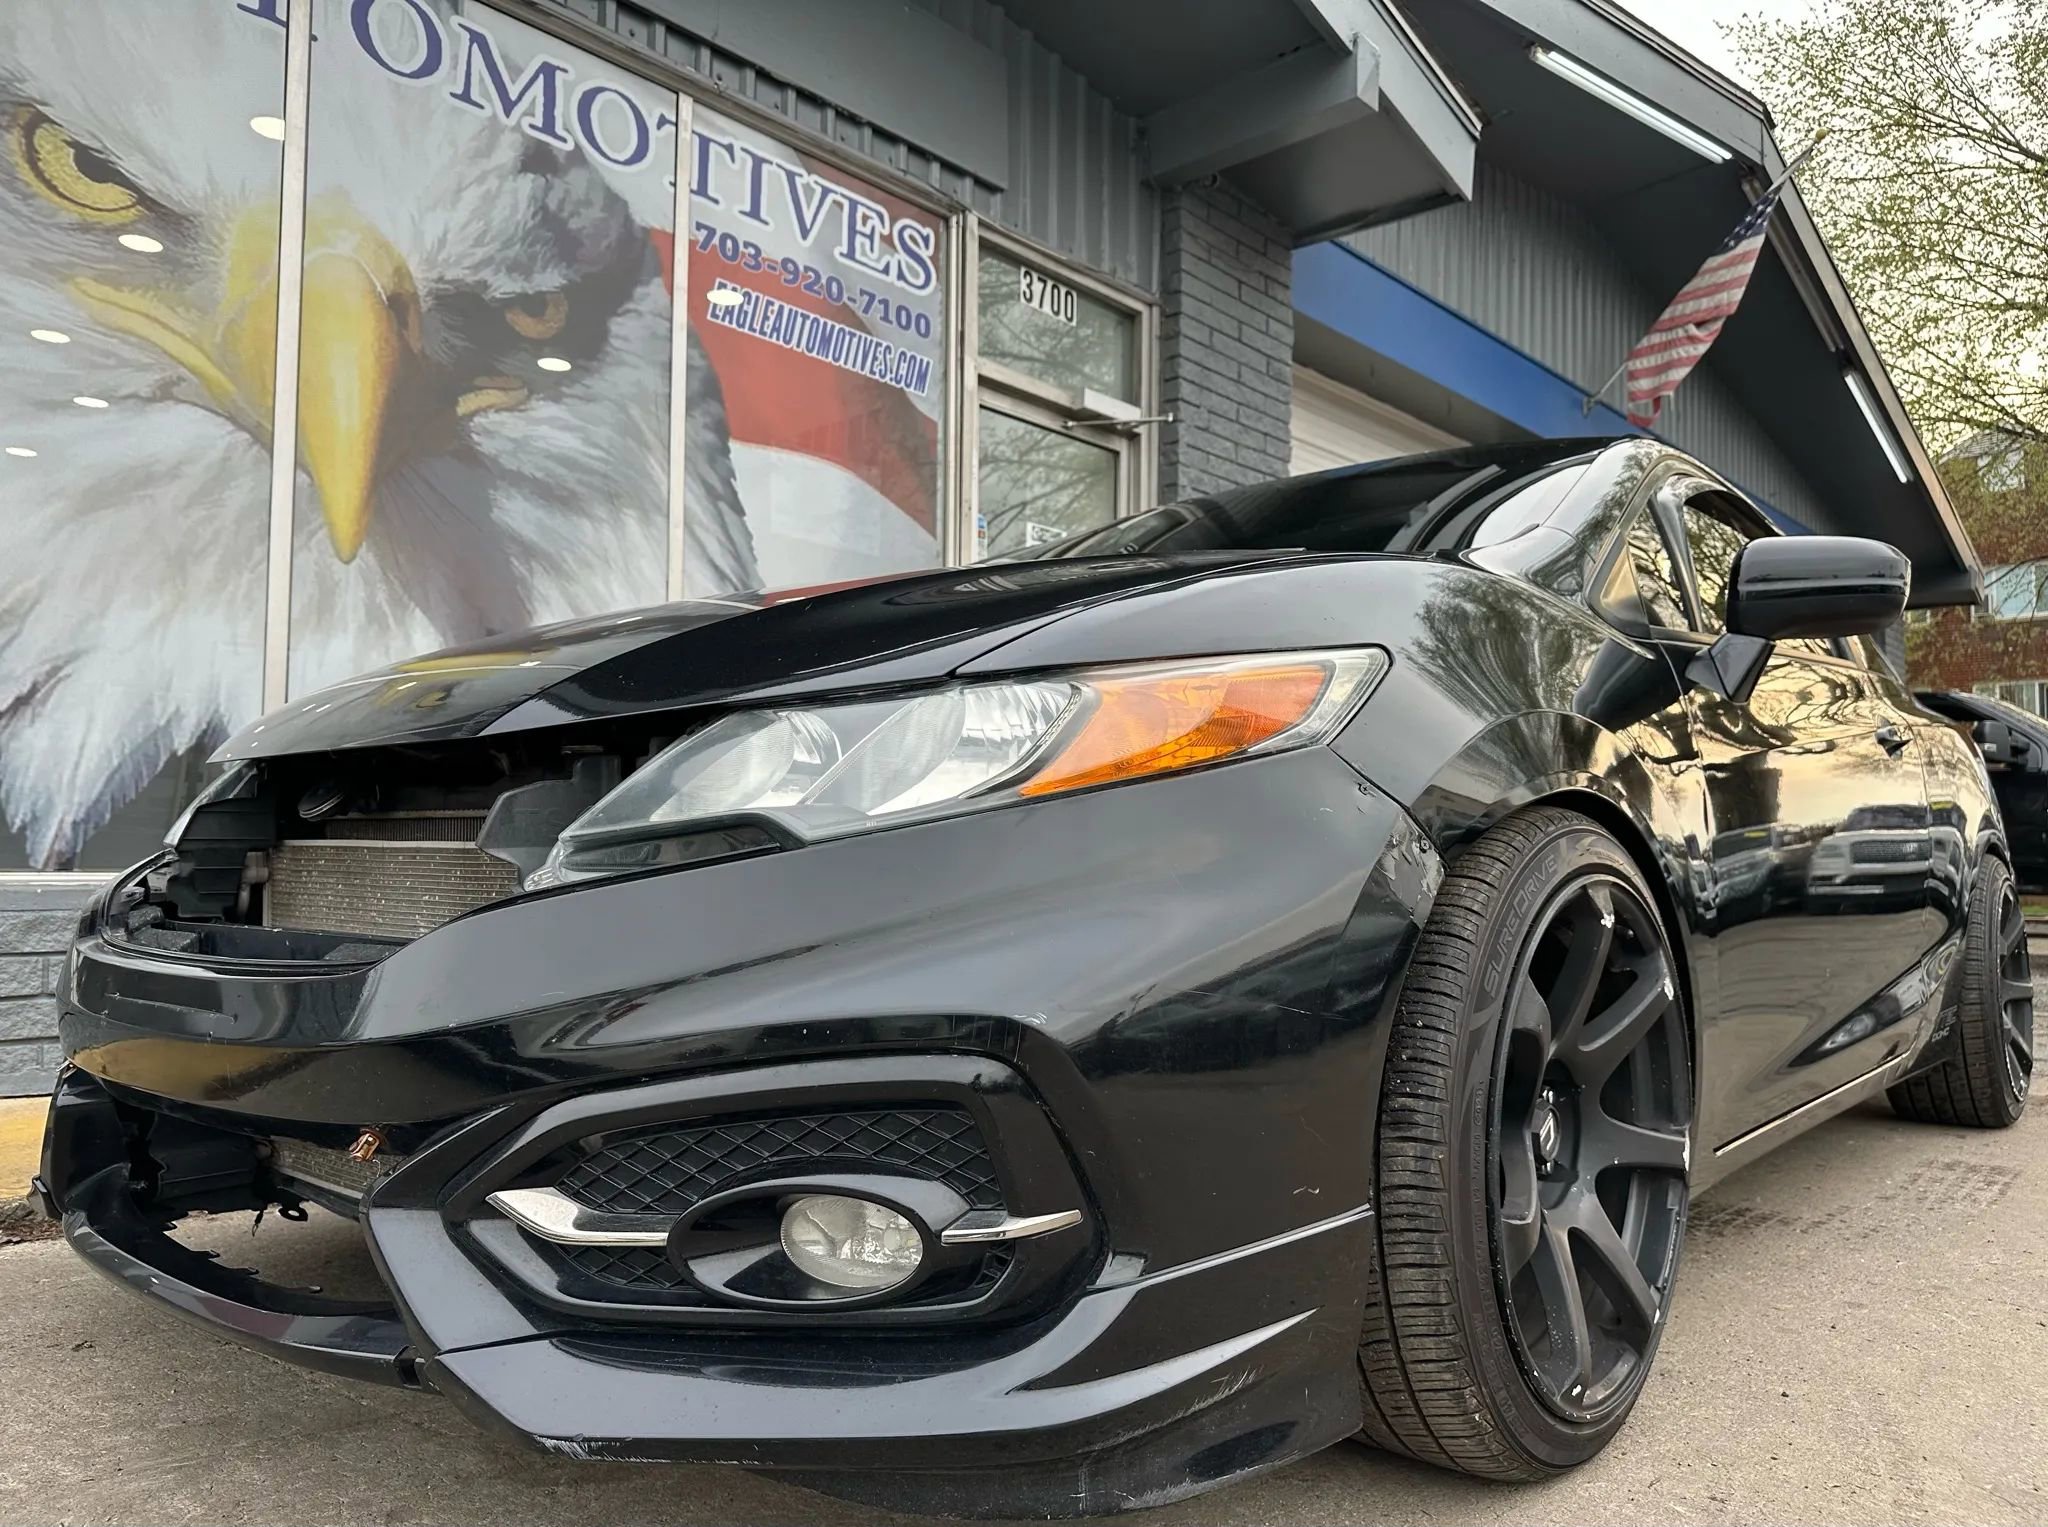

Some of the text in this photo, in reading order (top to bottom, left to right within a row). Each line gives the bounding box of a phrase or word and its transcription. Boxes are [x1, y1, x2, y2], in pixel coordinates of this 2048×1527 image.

[237, 0, 933, 290] OMOTIVES
[695, 221, 931, 339] 703-920-7100
[709, 281, 931, 394] EAGLEAUTOMOTIVES.COM
[1022, 269, 1075, 323] 3700
